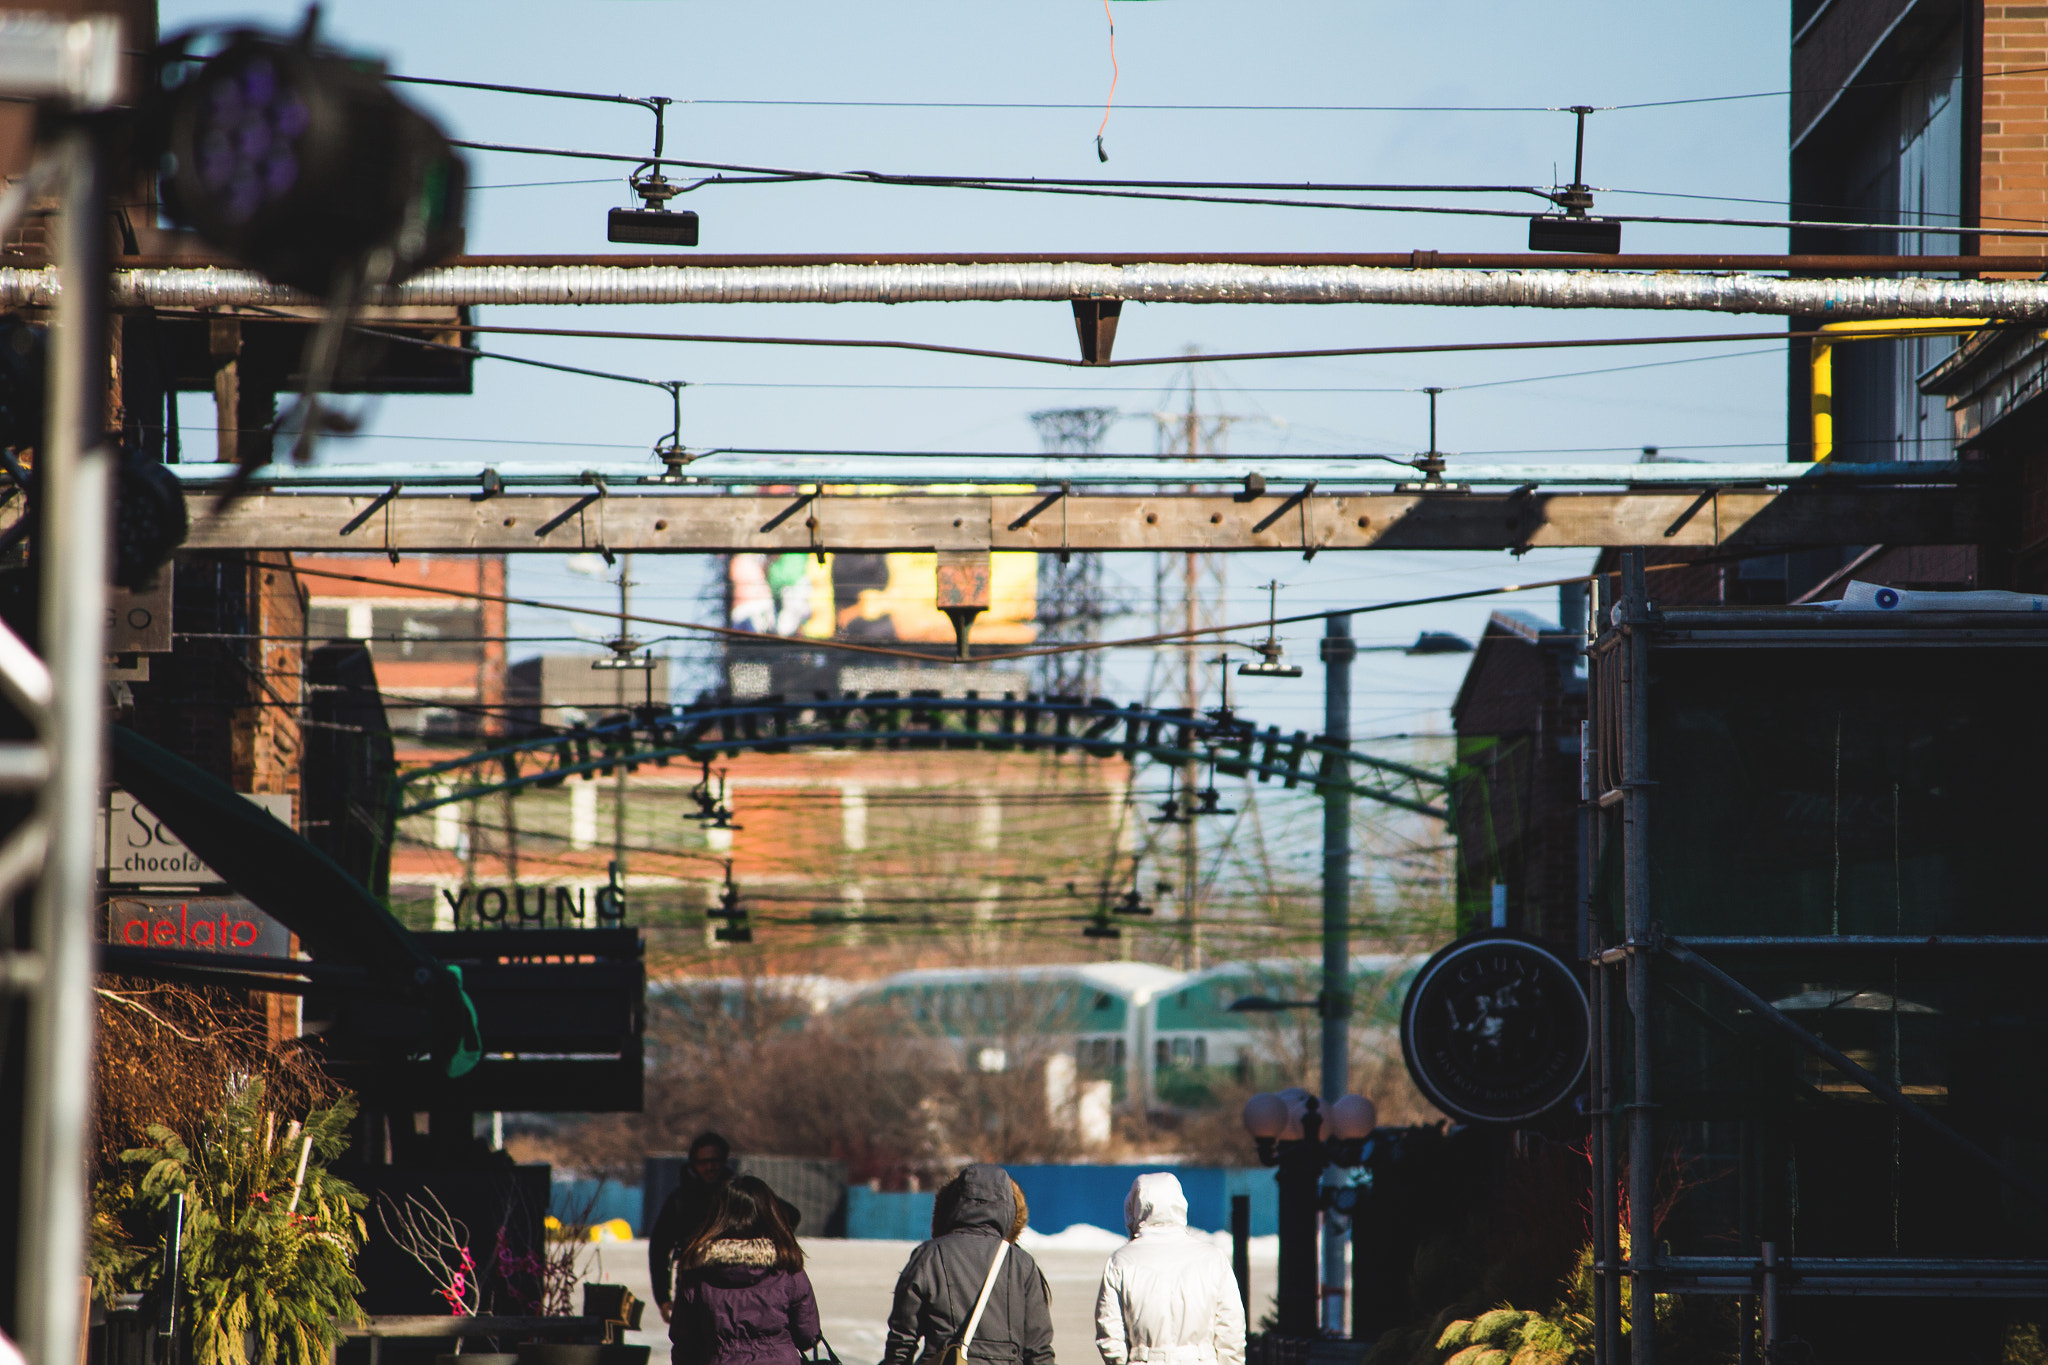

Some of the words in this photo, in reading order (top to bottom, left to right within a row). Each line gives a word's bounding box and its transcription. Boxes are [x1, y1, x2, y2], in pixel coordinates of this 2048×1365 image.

[123, 851, 209, 872] chocola
[122, 902, 259, 948] gelato
[442, 886, 626, 925] YOUNG
